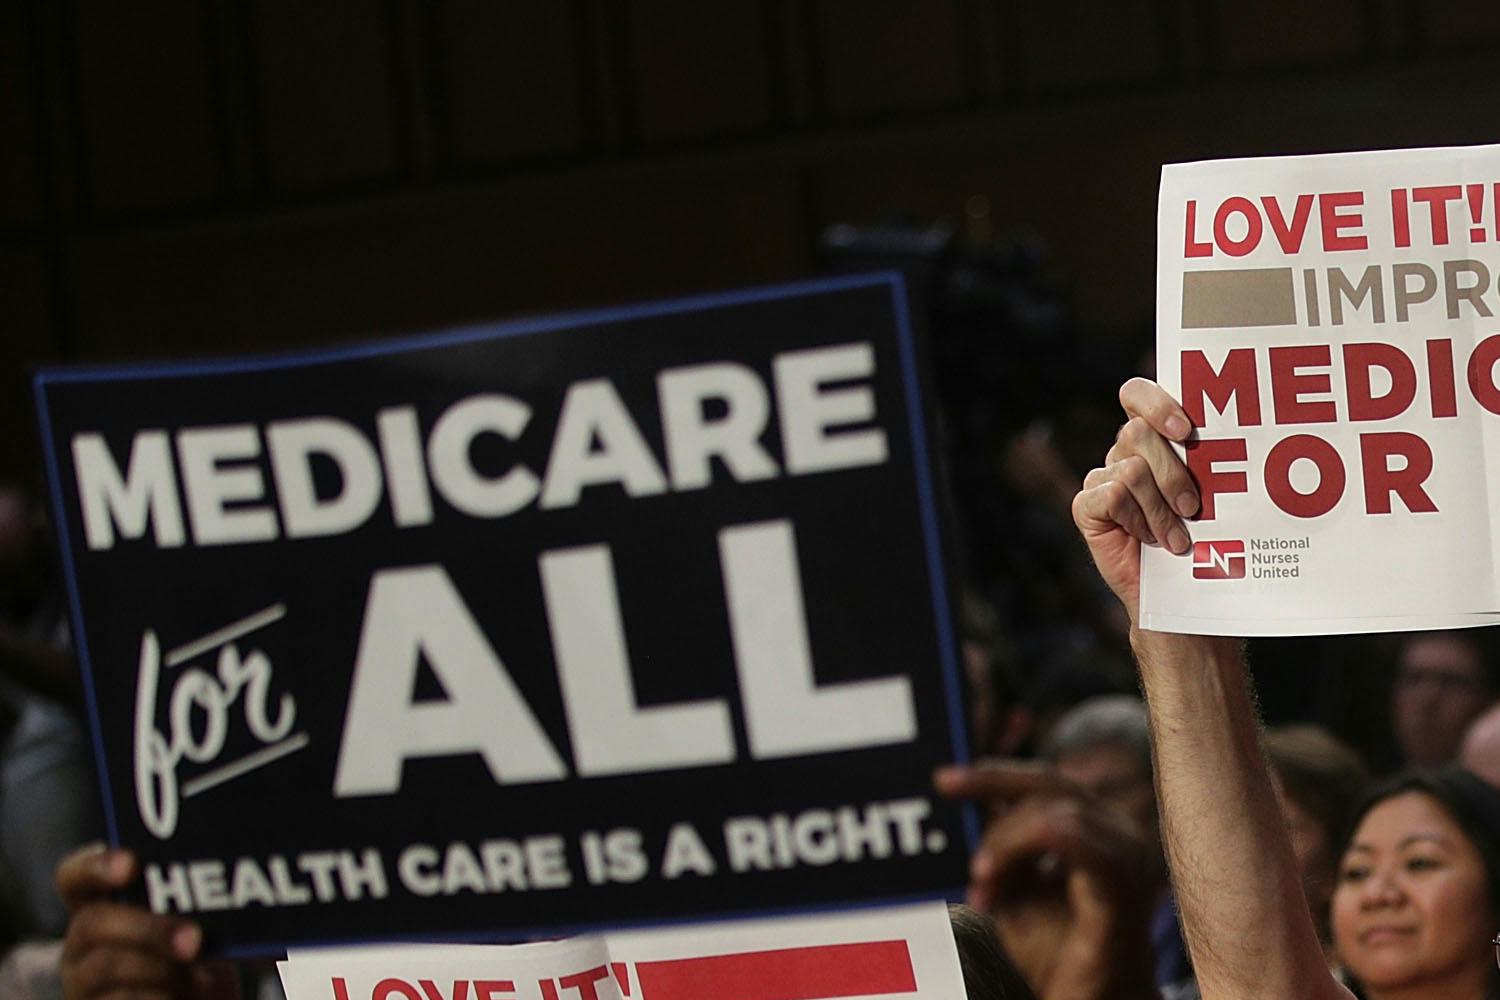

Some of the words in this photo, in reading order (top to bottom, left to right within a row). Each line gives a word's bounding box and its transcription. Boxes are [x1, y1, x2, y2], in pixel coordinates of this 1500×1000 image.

[1184, 191, 1368, 258] LOVE
[1392, 184, 1488, 247] IT!
[72, 342, 889, 550] MEDICARE
[1185, 432, 1438, 521] FOR
[1250, 537, 1310, 550] National
[1251, 553, 1300, 564] Nurses
[1252, 566, 1300, 578] United
[134, 628, 298, 839] for
[333, 519, 917, 797] ALL
[146, 848, 389, 916] HEALTH
[398, 835, 571, 896] CARE
[587, 826, 649, 885] IS
[661, 822, 717, 879] A
[724, 799, 947, 869] RIGHT.
